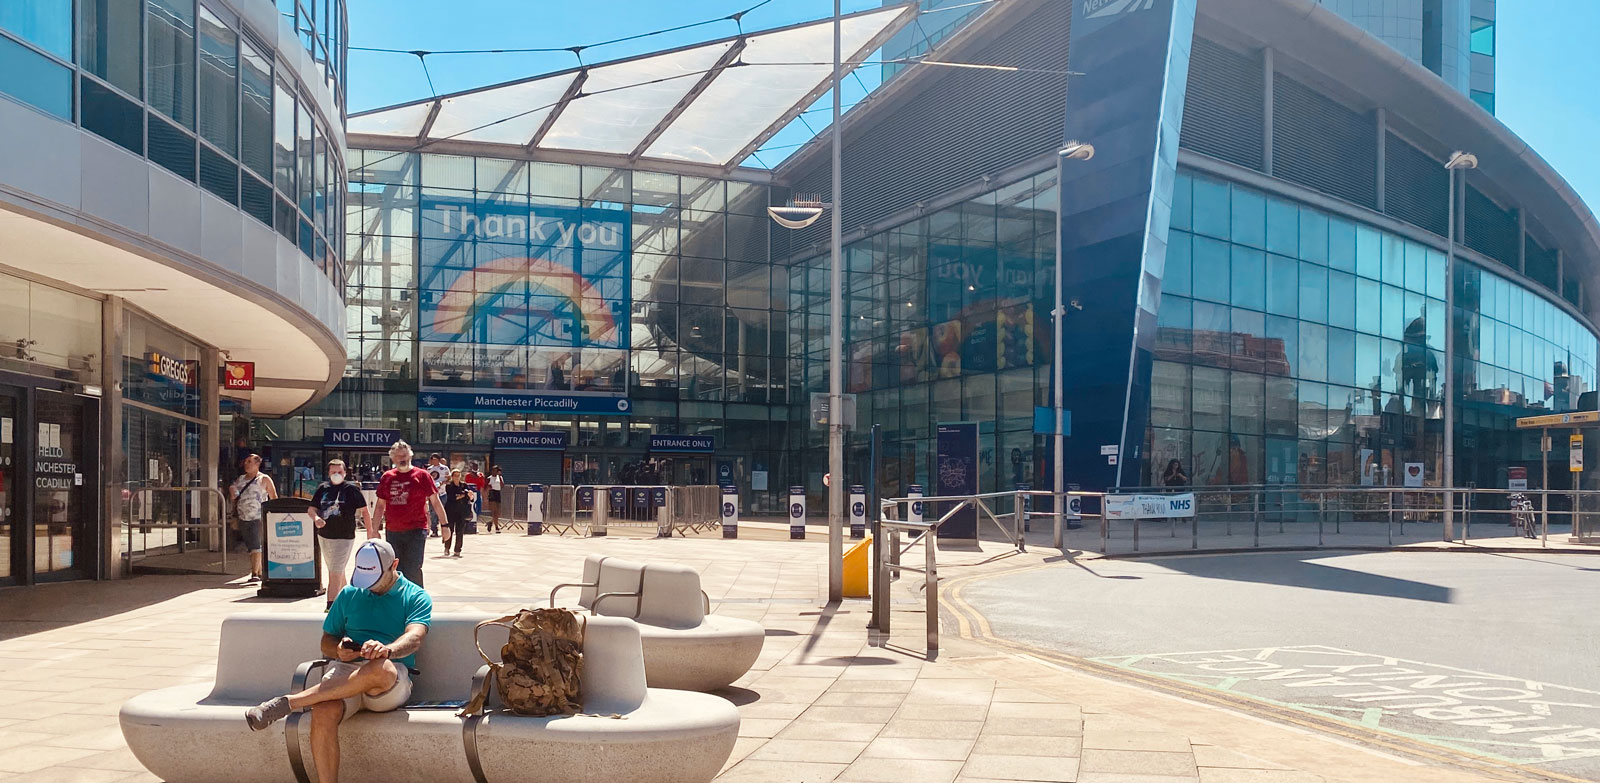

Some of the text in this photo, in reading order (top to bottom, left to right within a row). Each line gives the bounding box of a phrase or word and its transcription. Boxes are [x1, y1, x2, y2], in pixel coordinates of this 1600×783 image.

[435, 204, 618, 250] Thank you
[160, 355, 189, 384] GREGGS
[474, 396, 579, 410] Manchester Piccadilly
[332, 432, 391, 443] NO ENTRY
[497, 436, 563, 445] ENTRANCE ONLY
[652, 439, 712, 448] ENTRANCE ONLY
[39, 446, 64, 458] HELLO
[1170, 499, 1191, 510] NHS
[1304, 664, 1544, 701] ONLY
